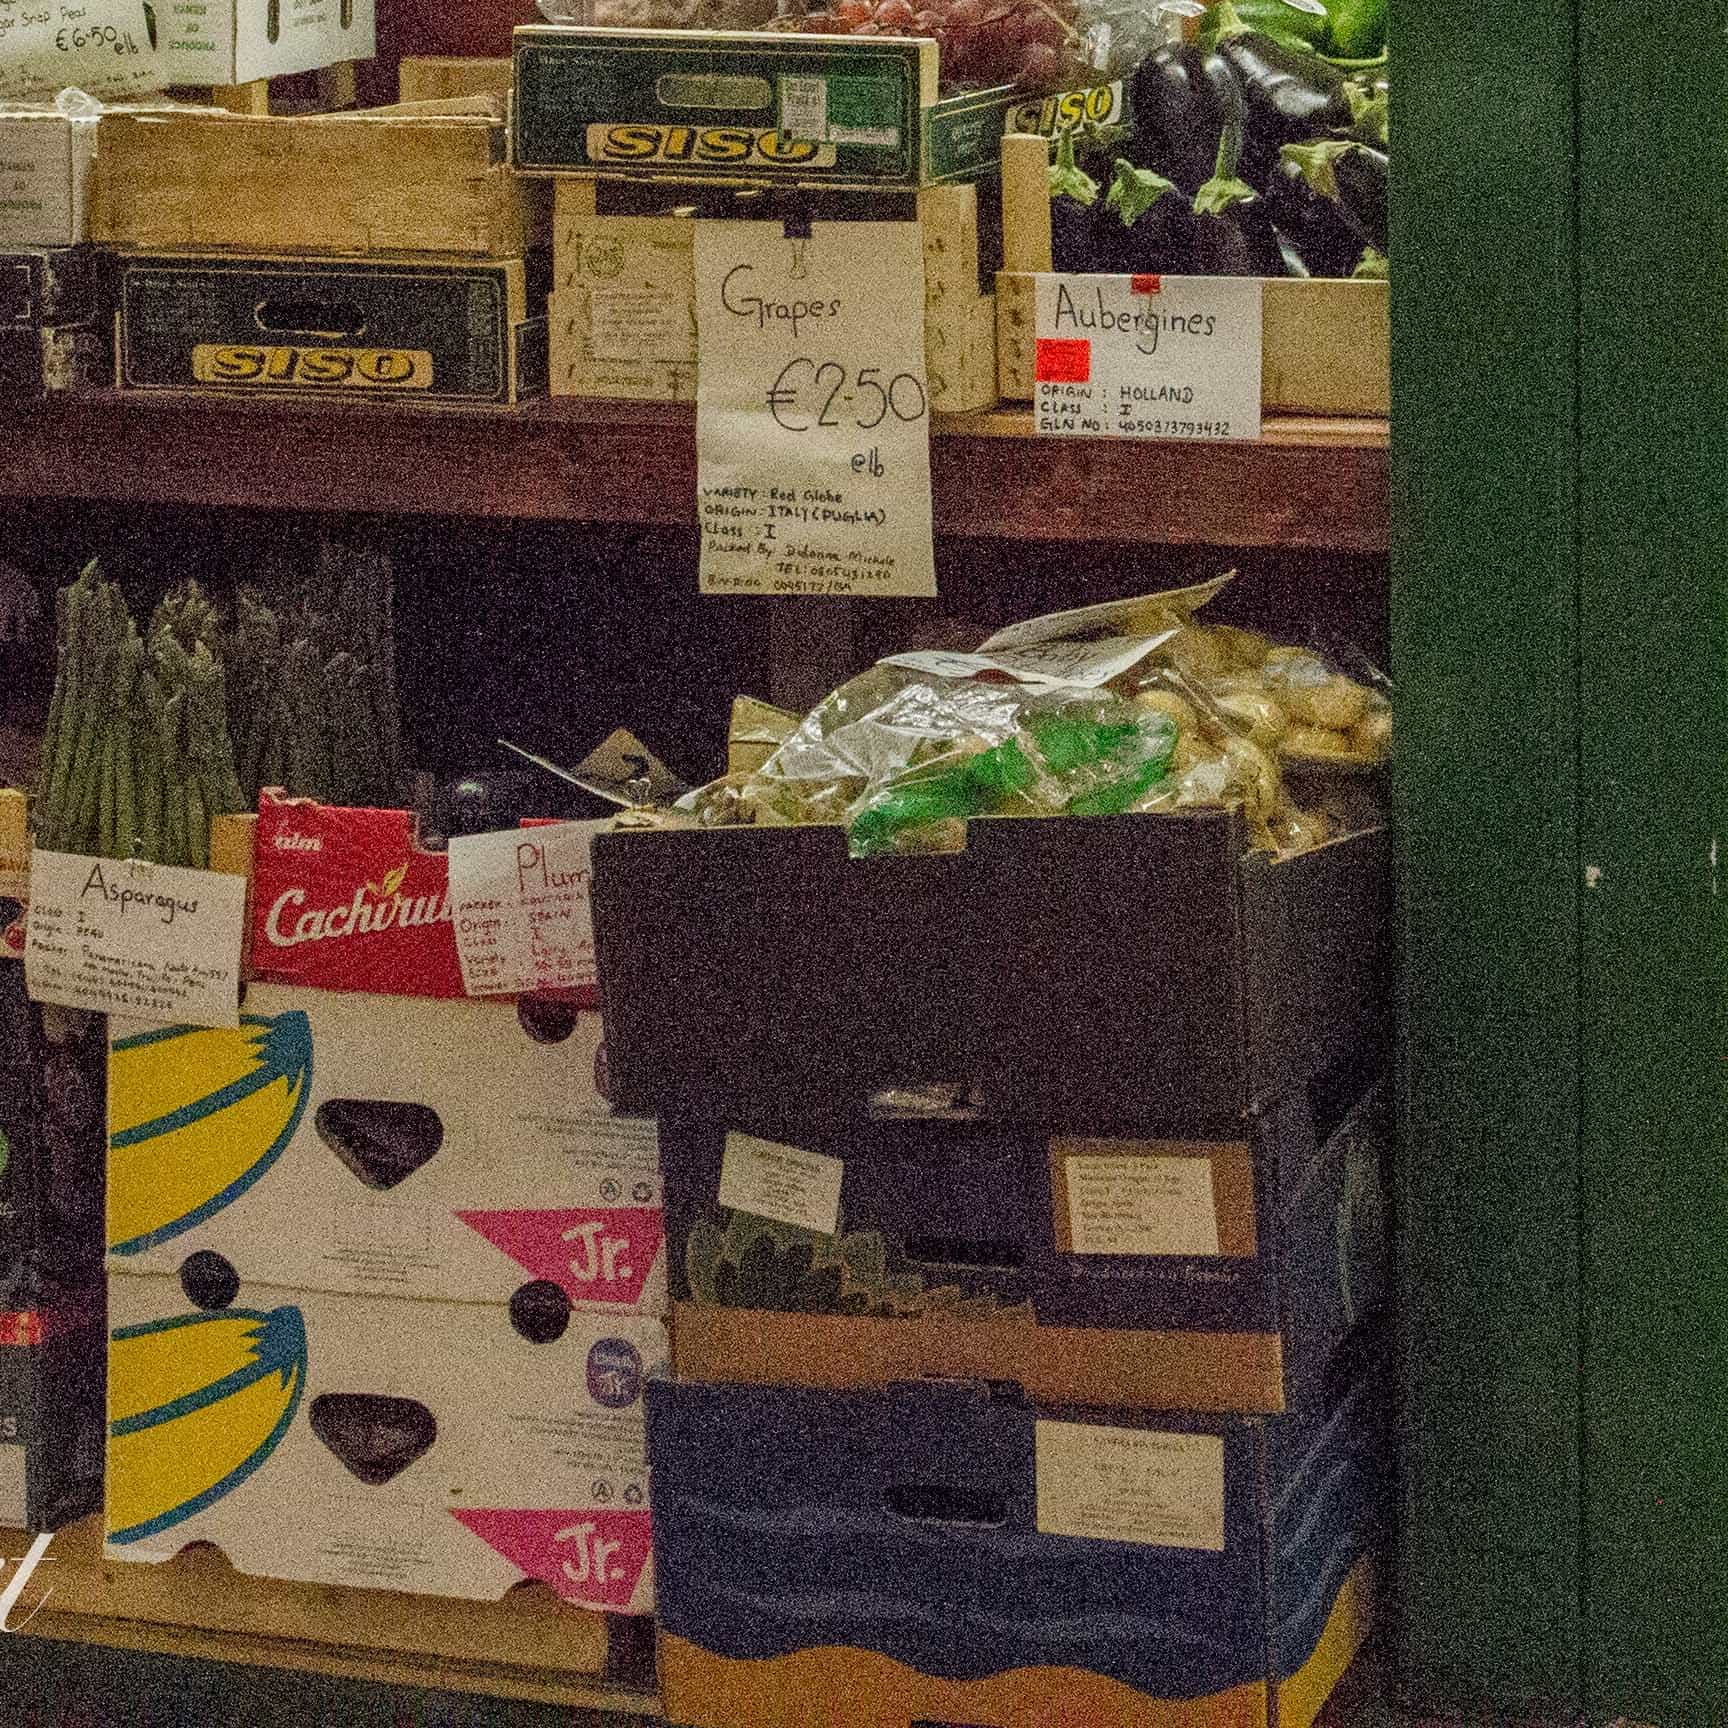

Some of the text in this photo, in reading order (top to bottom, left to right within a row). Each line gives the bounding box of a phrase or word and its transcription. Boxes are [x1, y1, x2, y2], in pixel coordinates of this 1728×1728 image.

[603, 125, 819, 164] SISO
[720, 264, 842, 338] Grapes
[1055, 283, 1217, 355] Aubergines
[209, 344, 417, 386] SISO
[1040, 383, 1195, 404] ORIGIN HOLLAND
[1040, 400, 1082, 415] CLASS
[770, 487, 797, 502] Red
[803, 489, 843, 504] Globe
[80, 862, 200, 925] Asparagus
[560, 1221, 632, 1284] Jr.
[552, 1521, 625, 1584] Jr.
